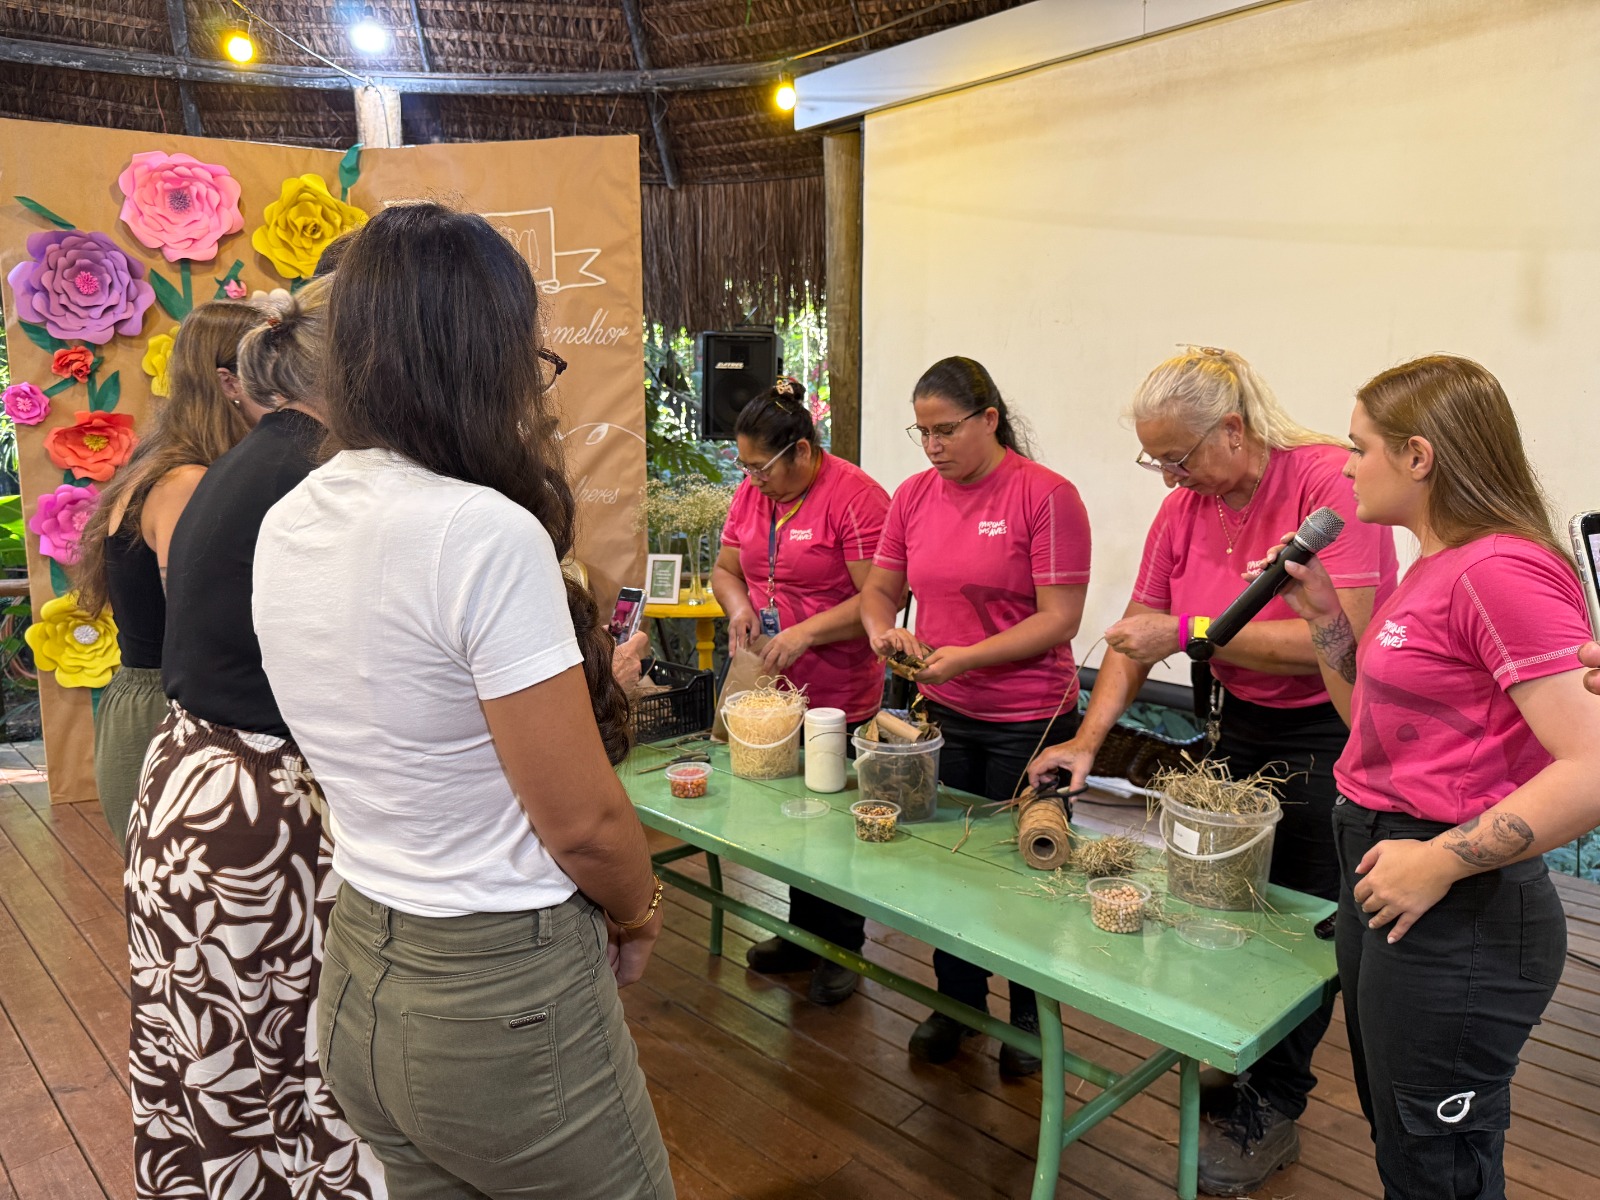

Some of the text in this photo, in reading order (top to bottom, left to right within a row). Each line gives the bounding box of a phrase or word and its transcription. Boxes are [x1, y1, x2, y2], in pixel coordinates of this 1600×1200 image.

[553, 307, 629, 346] melhor
[575, 475, 620, 504] lheres
[988, 526, 1007, 537] AVES
[1380, 633, 1408, 648] AVES
